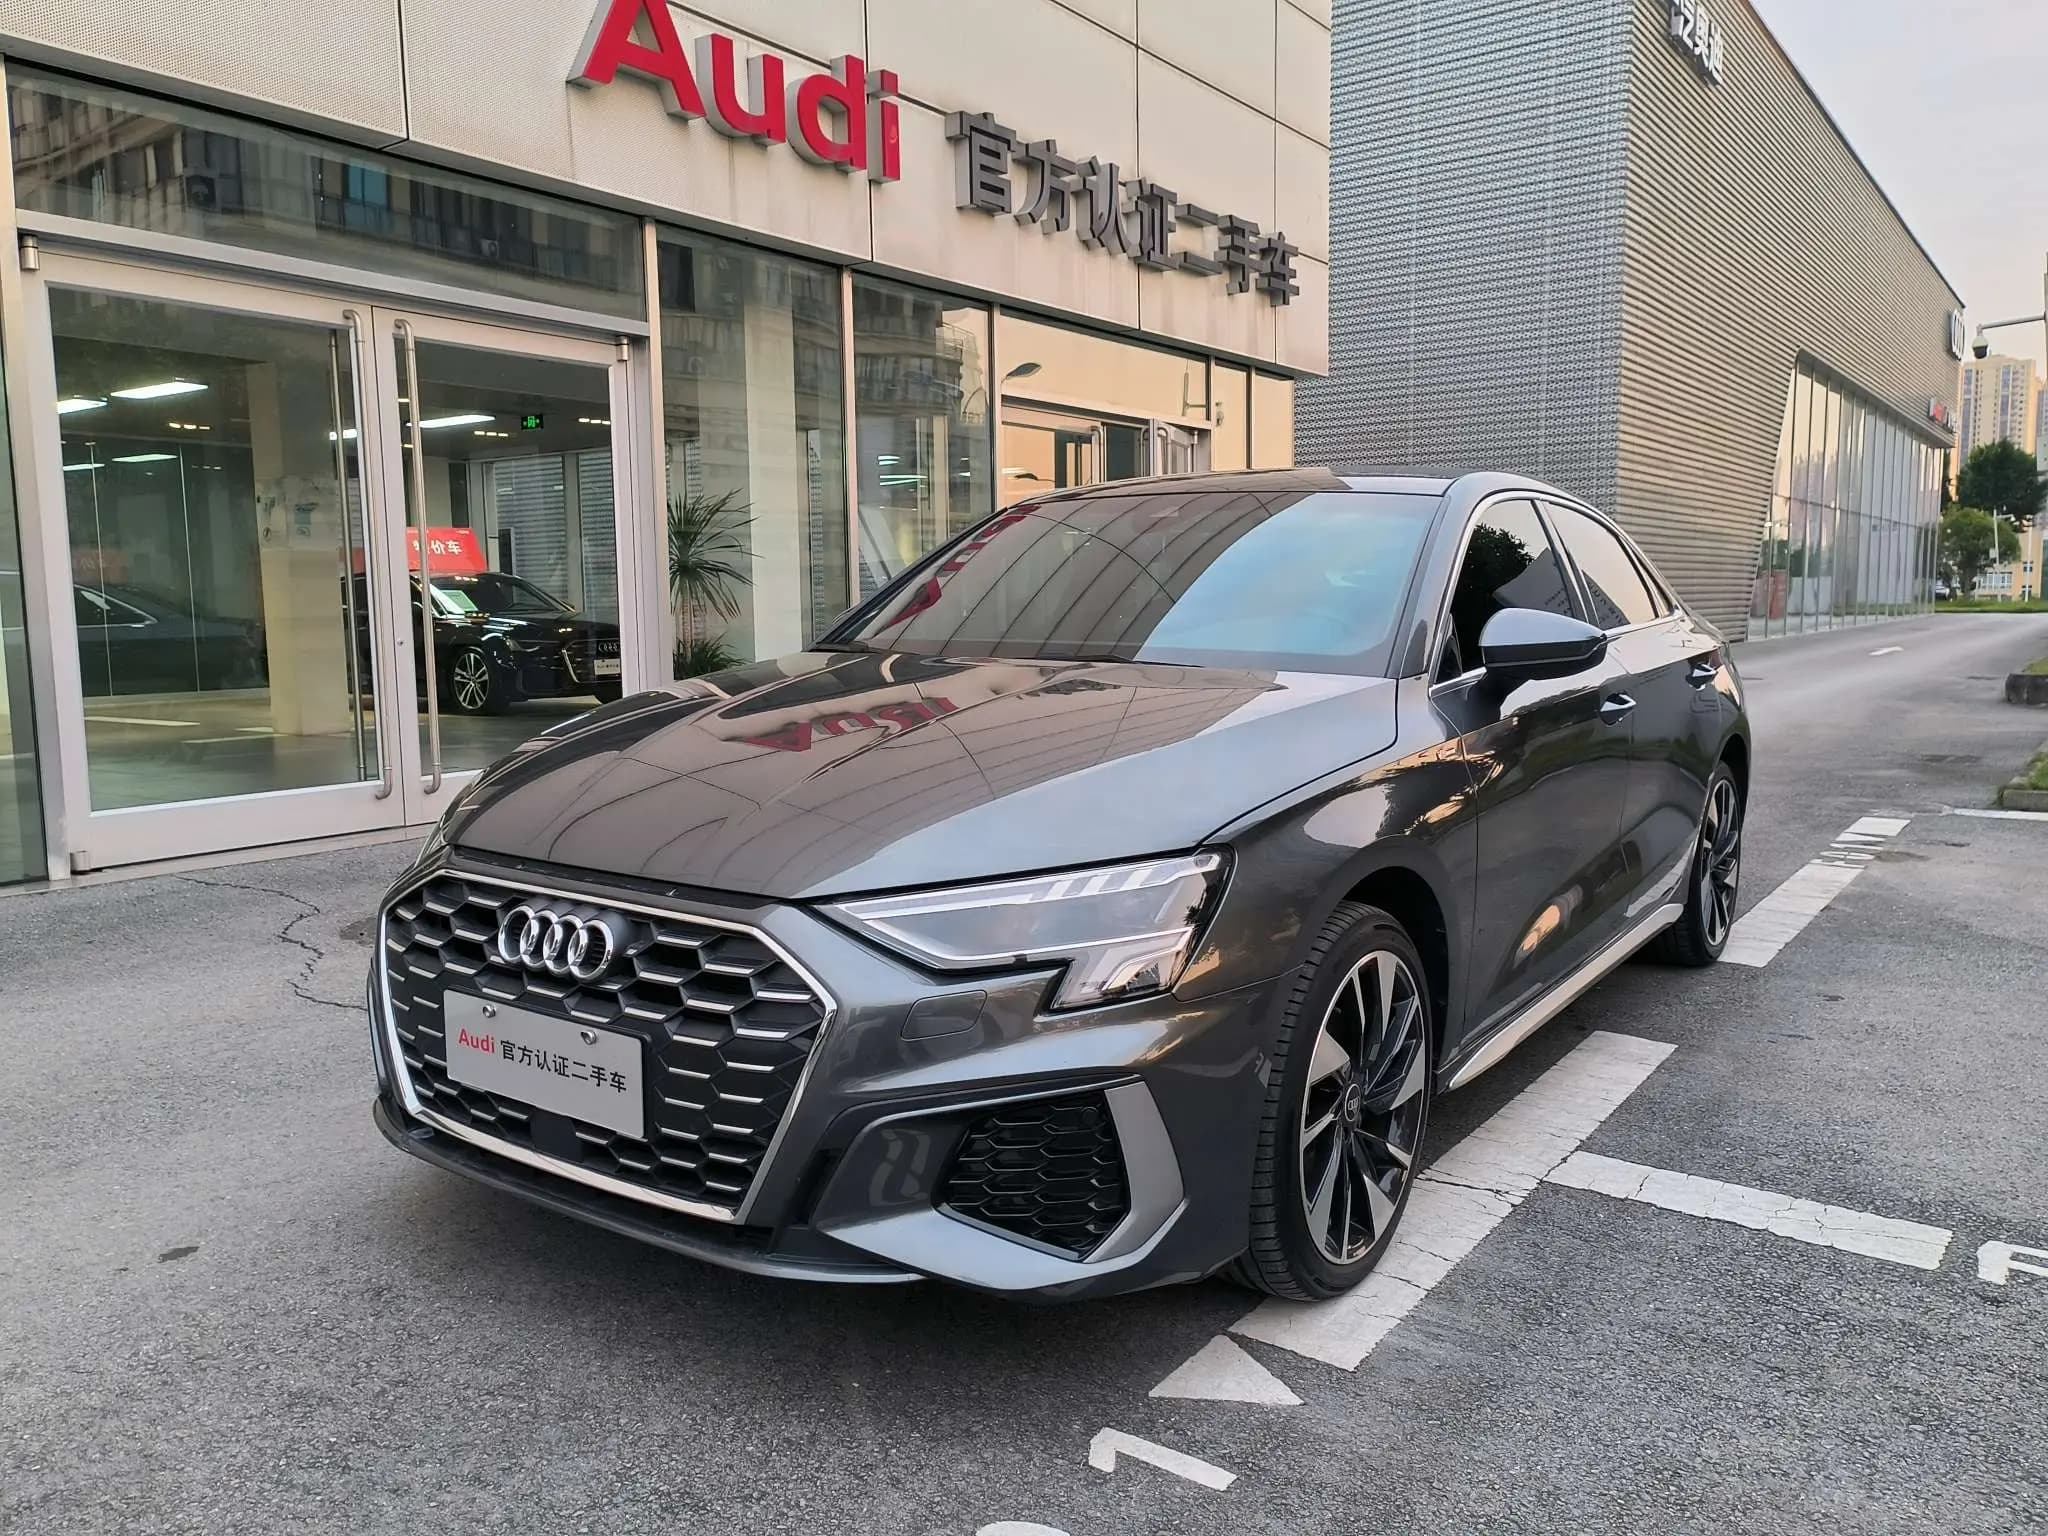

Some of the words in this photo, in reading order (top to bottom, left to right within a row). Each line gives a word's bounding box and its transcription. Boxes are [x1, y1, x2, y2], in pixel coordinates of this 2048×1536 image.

[567, 0, 901, 184] Audi
[945, 111, 1300, 307] 官方认证二手车
[458, 1028, 496, 1054] Audi
[500, 1039, 627, 1093] 官方认证二手车
